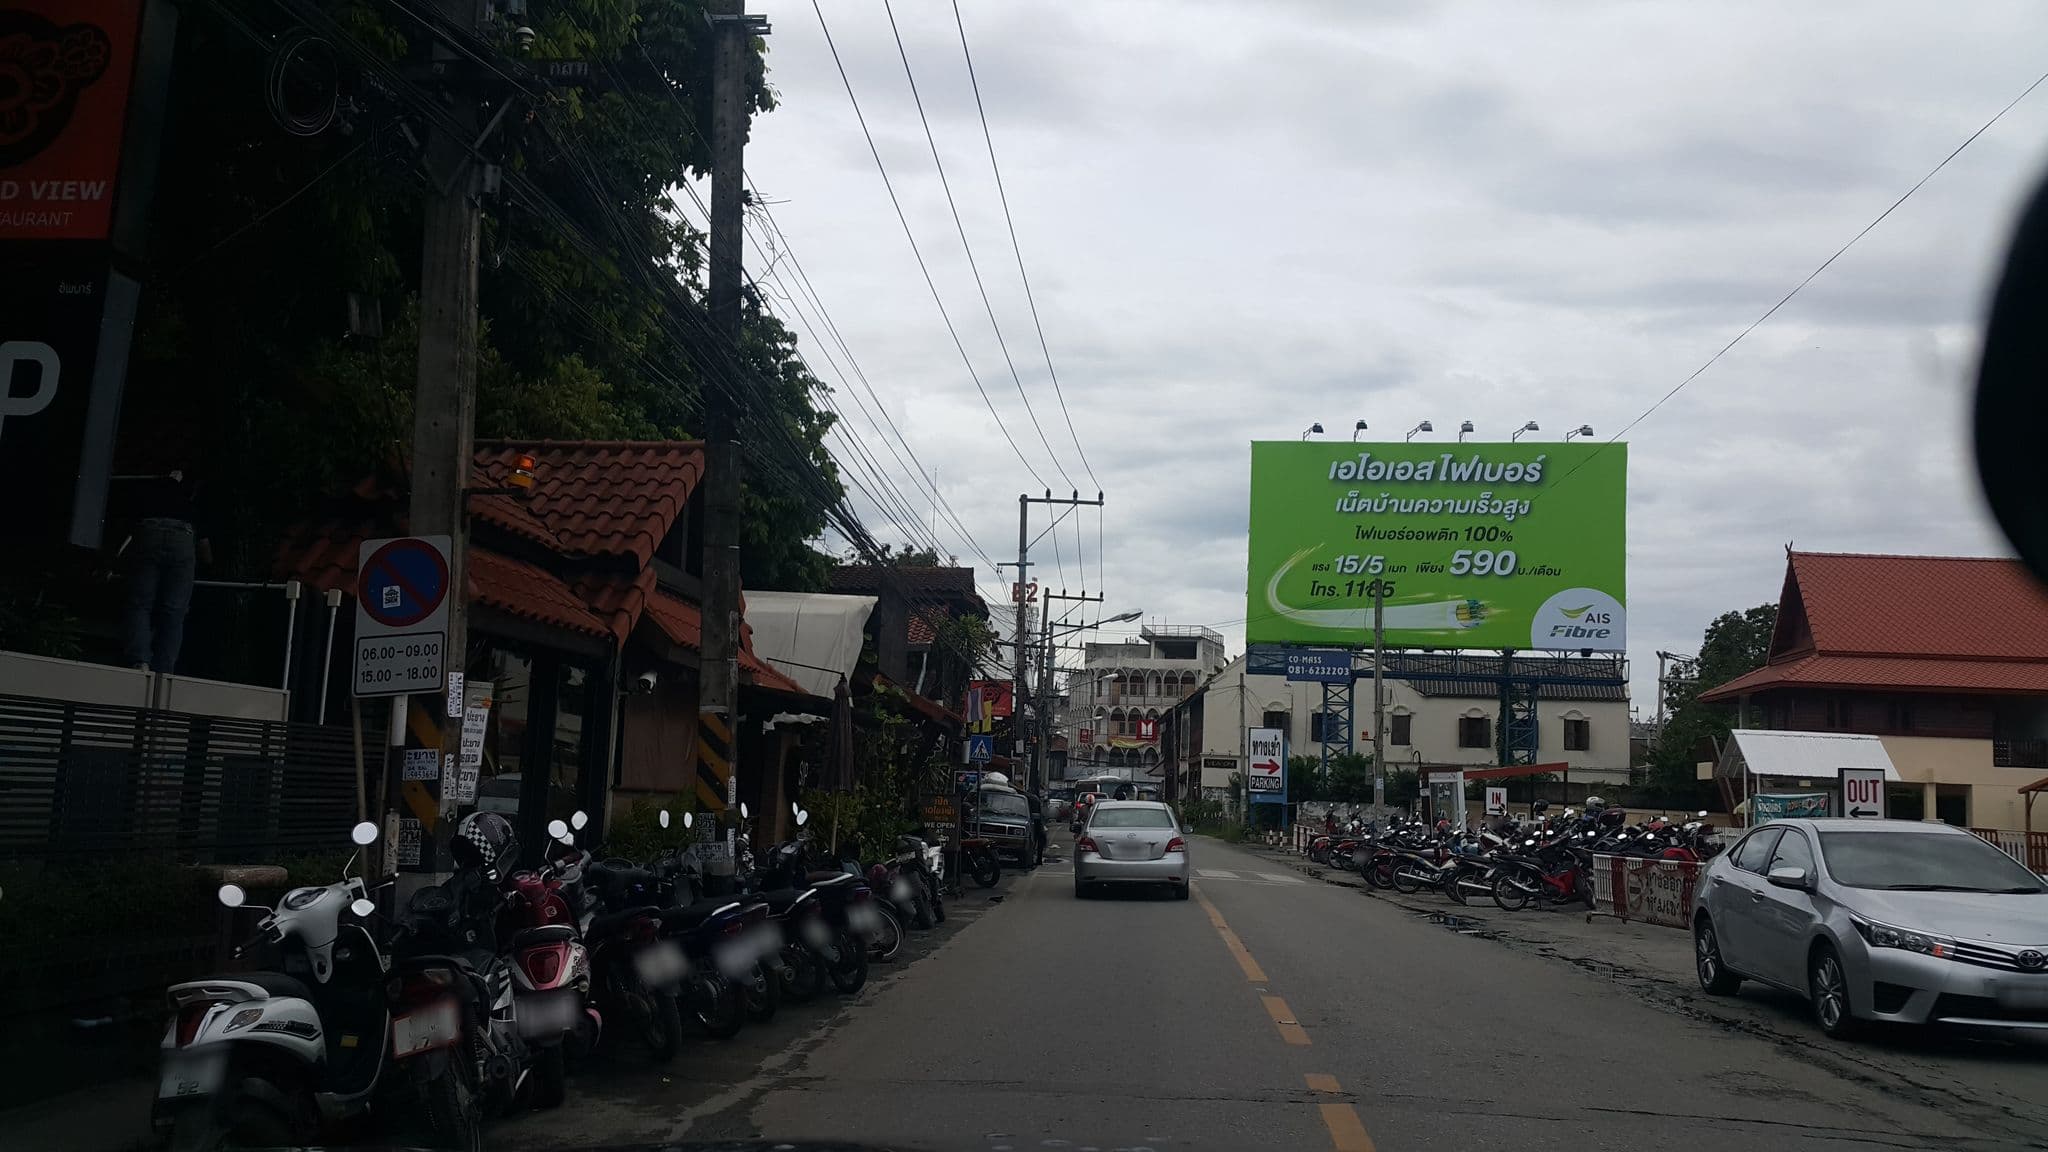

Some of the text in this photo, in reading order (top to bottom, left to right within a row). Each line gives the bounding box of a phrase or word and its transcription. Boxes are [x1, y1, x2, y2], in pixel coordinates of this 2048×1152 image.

[31, 180, 107, 201] VIEW
[1328, 453, 1546, 482] เอไอเอส ไฟเบอร์
[1335, 490, 1531, 522] เน็ตบ้านความเร็วสูง
[1463, 526, 1513, 543] 100%
[1312, 549, 1561, 577] แรง 15/5 เมก เพียง 590 บ./เดือน
[1310, 580, 1340, 597] โทร.
[1585, 612, 1611, 624] AIS
[1550, 625, 1611, 639] Fibre
[362, 646, 395, 660] 06.00
[406, 643, 438, 657] 09.00
[361, 669, 391, 683] 15.00
[407, 666, 437, 680] 18.00
[1288, 666, 1350, 676] 081-6232203
[1252, 734, 1281, 757] ทางเข้า
[1251, 776, 1280, 790] PARKING
[1848, 779, 1880, 803] OUT
[1492, 791, 1501, 805] IN
